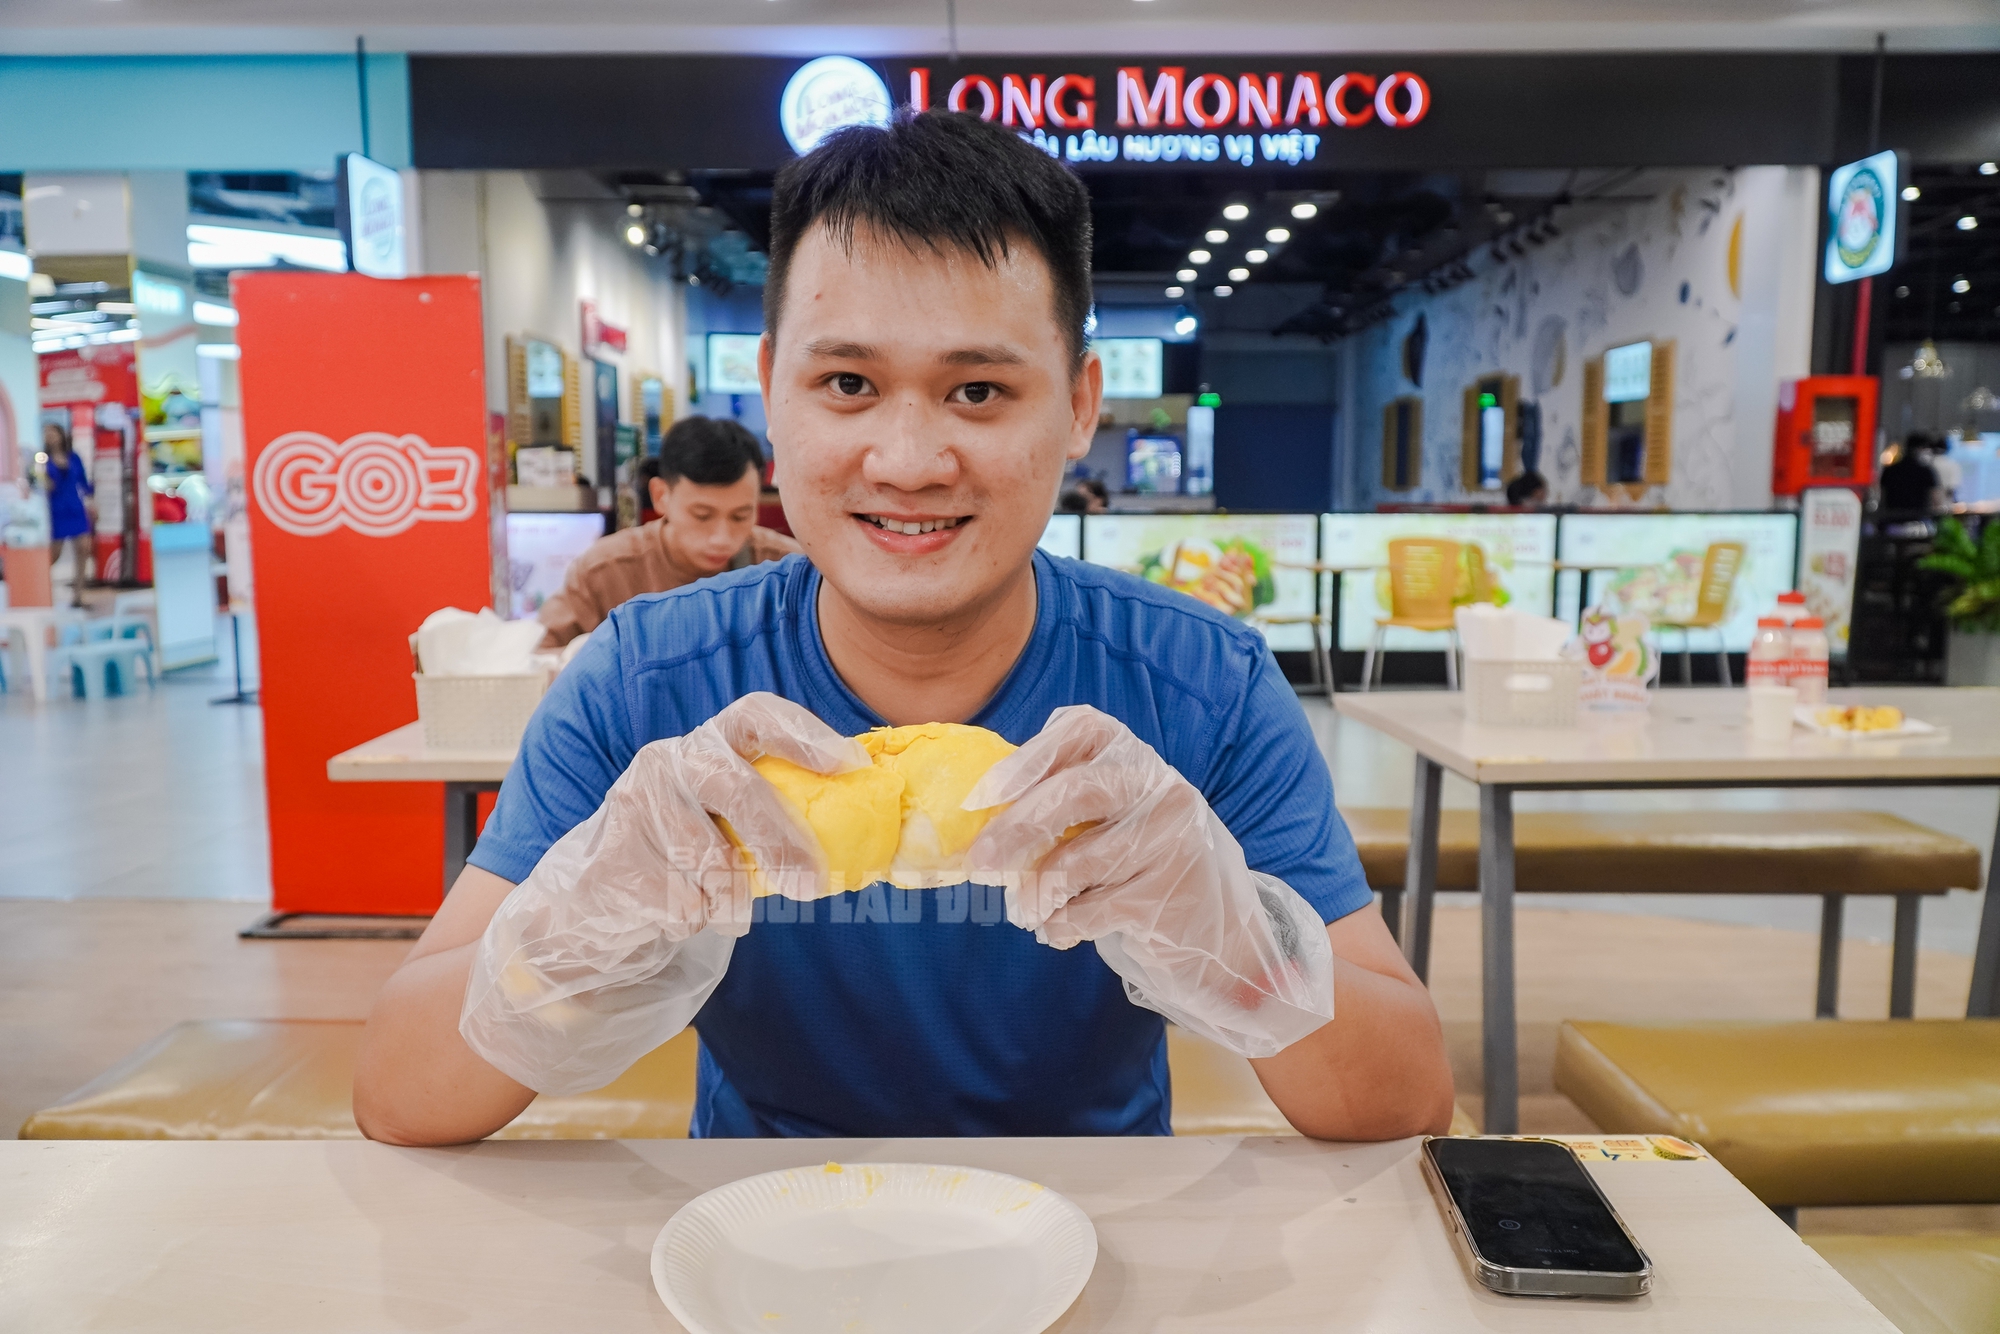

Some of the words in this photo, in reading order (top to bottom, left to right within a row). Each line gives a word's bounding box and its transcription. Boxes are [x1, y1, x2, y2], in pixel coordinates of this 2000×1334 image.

[909, 67, 1096, 129] LONG
[1115, 66, 1431, 129] MONACO
[1066, 129, 1119, 162] LÂU
[1123, 133, 1220, 162] HƯƠNG
[1223, 134, 1254, 167] VỊ
[1259, 128, 1321, 166] VIỆT
